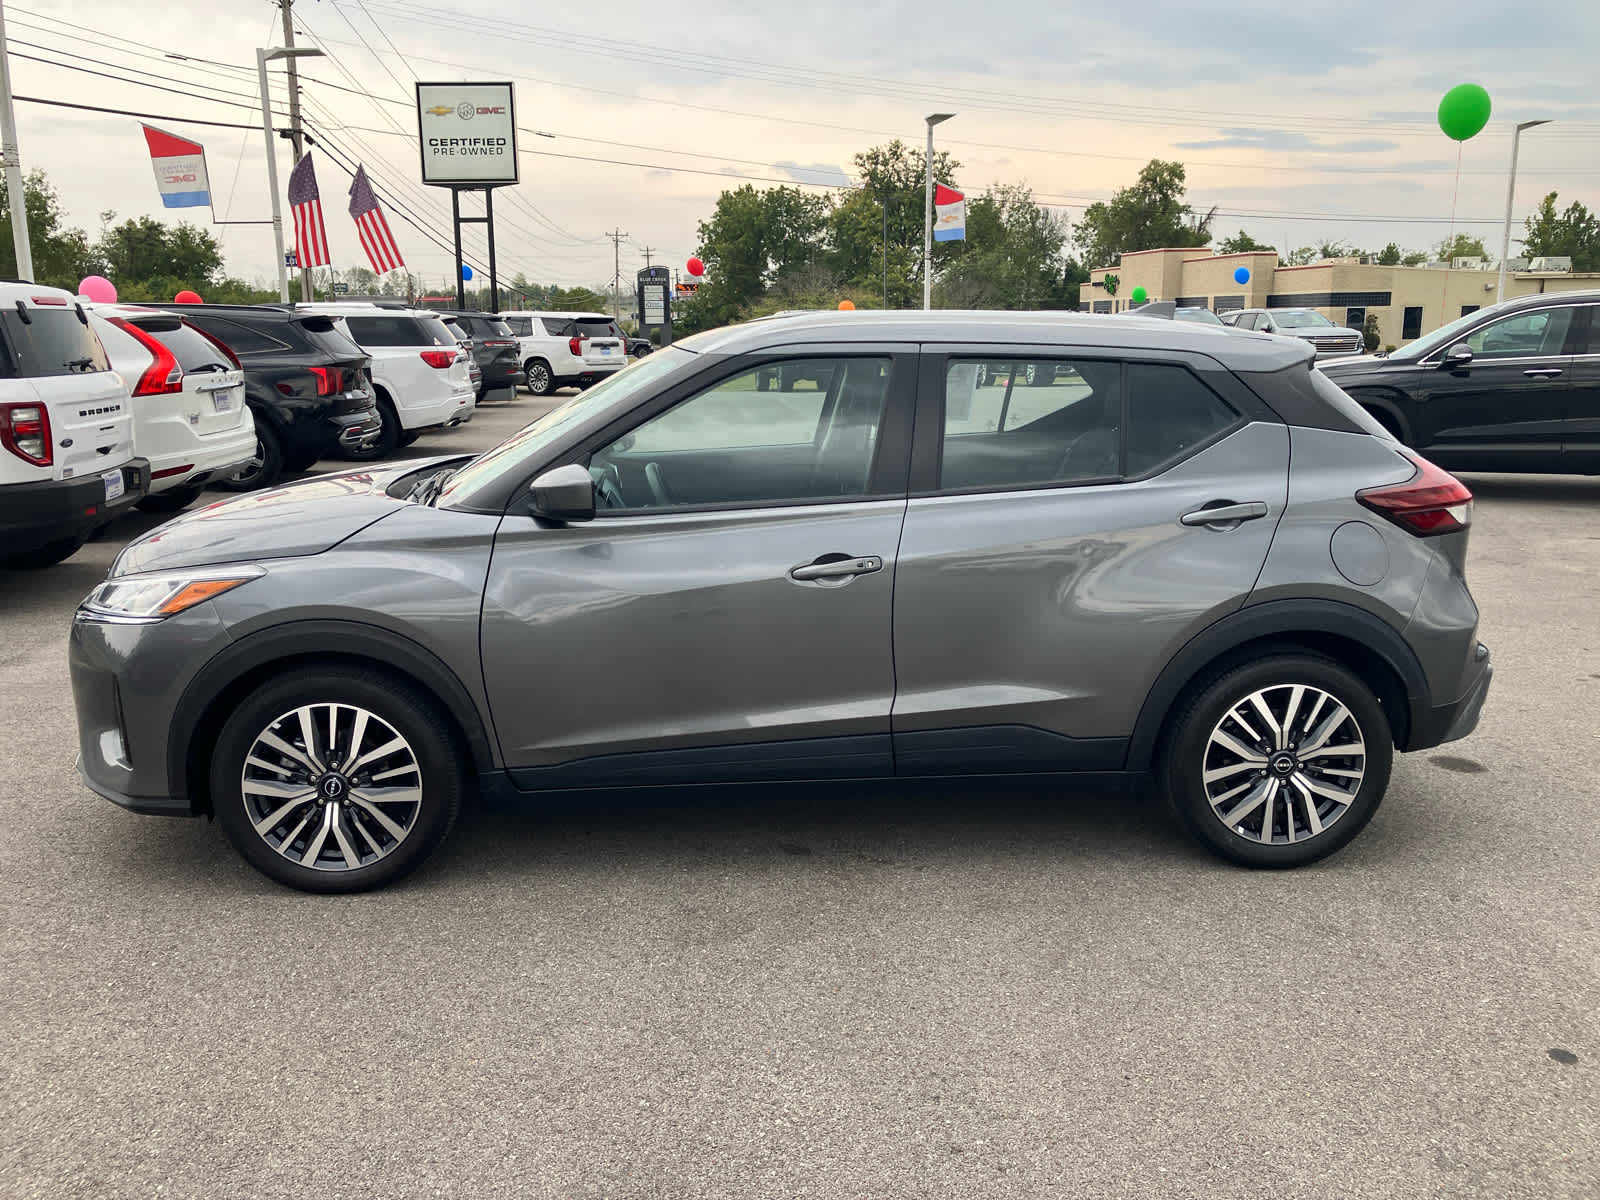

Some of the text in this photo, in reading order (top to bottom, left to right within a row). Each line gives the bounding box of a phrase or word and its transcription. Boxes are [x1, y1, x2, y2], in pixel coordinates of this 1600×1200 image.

[429, 138, 506, 146] CERTIFIED
[433, 147, 503, 156] PRE-OWNED
[79, 405, 121, 417] BRONCO
